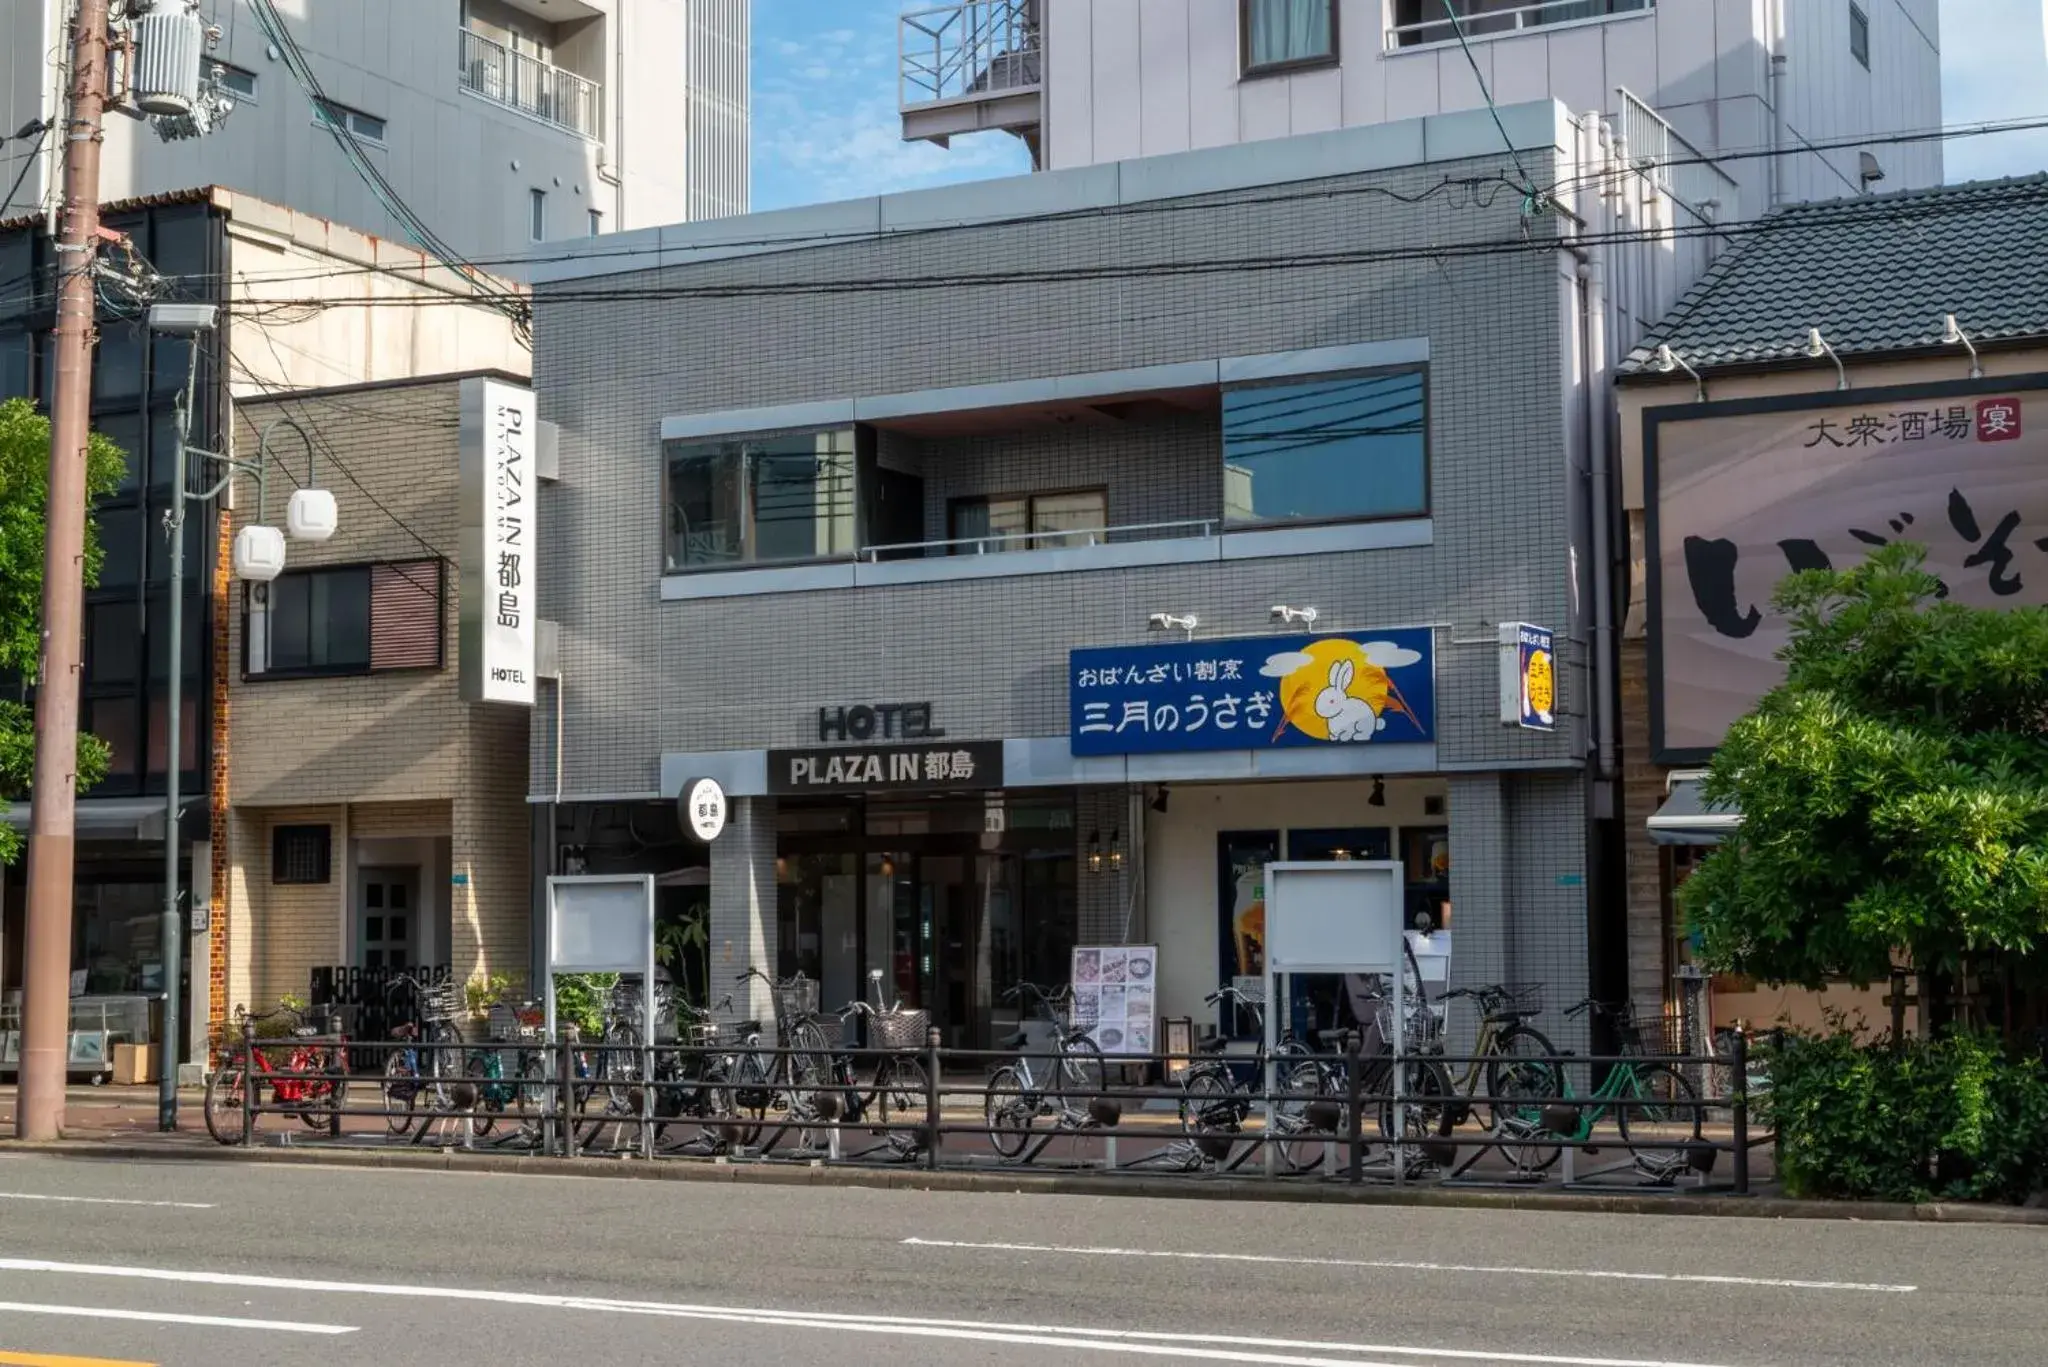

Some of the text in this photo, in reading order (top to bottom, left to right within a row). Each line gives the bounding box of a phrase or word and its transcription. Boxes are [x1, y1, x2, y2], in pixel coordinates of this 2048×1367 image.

[1804, 404, 2016, 448] 大衆酒場 宴
[497, 405, 505, 544] MIYAKOJIMA
[497, 407, 522, 629] PLAZA IN 都島
[491, 667, 526, 684] HOTEL
[1079, 659, 1243, 688] おばんざい割烹
[819, 702, 946, 742] HOTEL
[1079, 690, 1274, 734] 三月のうさぎ
[790, 750, 975, 785] PLAZA IN 都島
